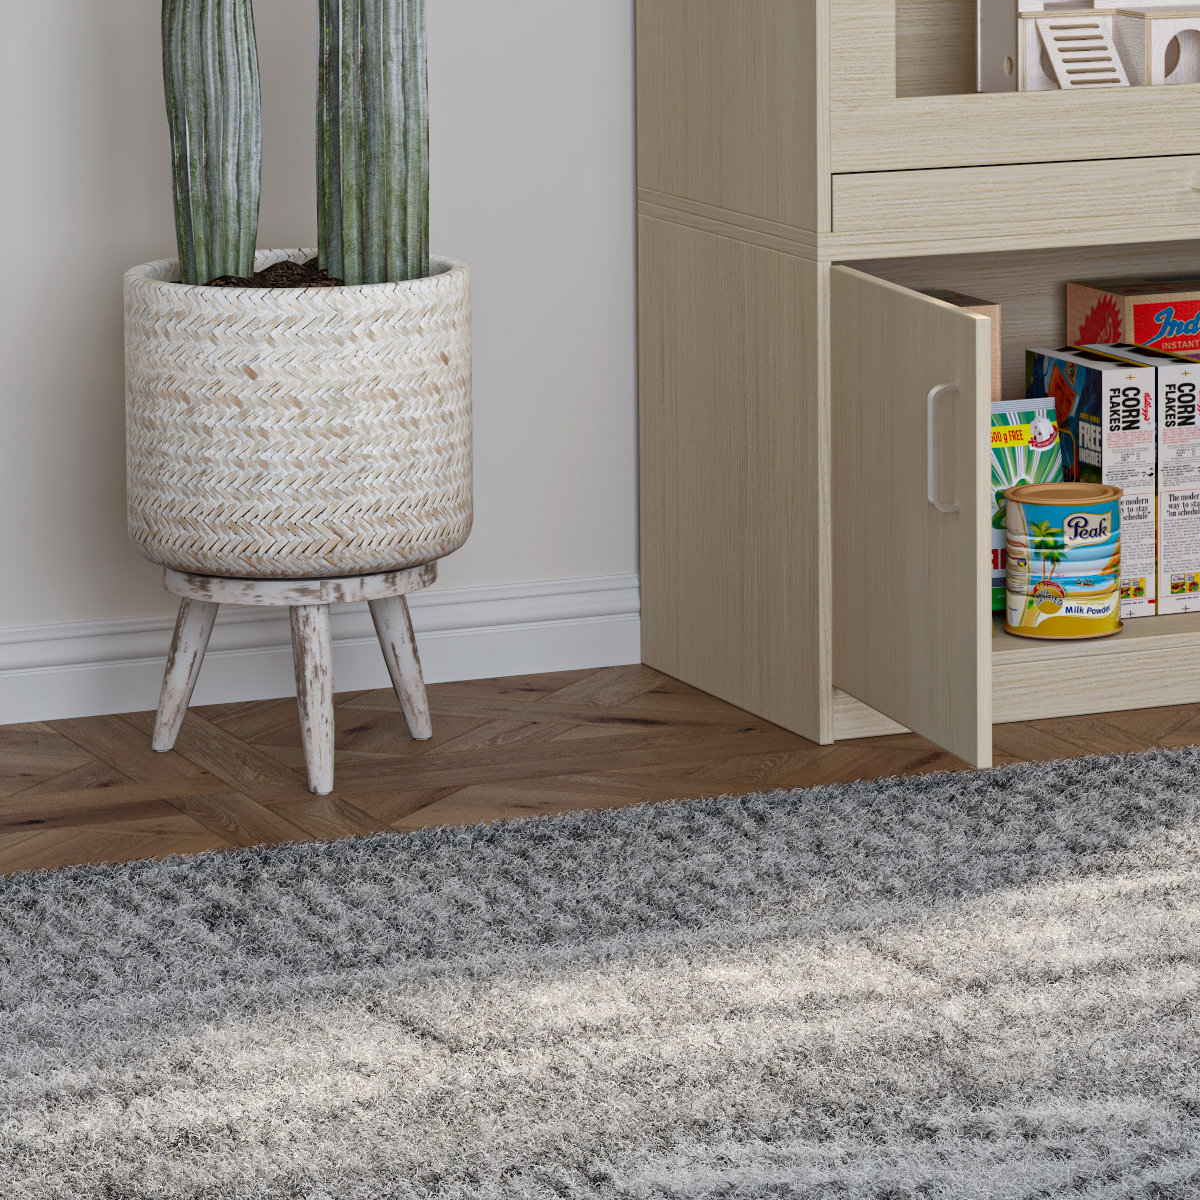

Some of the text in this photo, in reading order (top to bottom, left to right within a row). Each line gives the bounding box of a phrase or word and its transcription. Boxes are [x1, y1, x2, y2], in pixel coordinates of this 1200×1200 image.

[1162, 340, 1199, 351] INSTANT
[1109, 388, 1121, 432] FLAKES
[1121, 386, 1141, 431] CORN
[1165, 383, 1176, 428] FLAKES
[1177, 382, 1196, 427] CORN
[1003, 433, 1008, 444] g
[1008, 429, 1024, 441] FREE
[1078, 420, 1102, 453] FREE
[1125, 498, 1149, 506] modern
[1168, 493, 1180, 502] The
[1135, 505, 1149, 514] stay
[1168, 502, 1180, 510] way
[1182, 501, 1189, 509] to
[1067, 516, 1108, 540] Peak
[1065, 605, 1111, 615] Milk Powder
